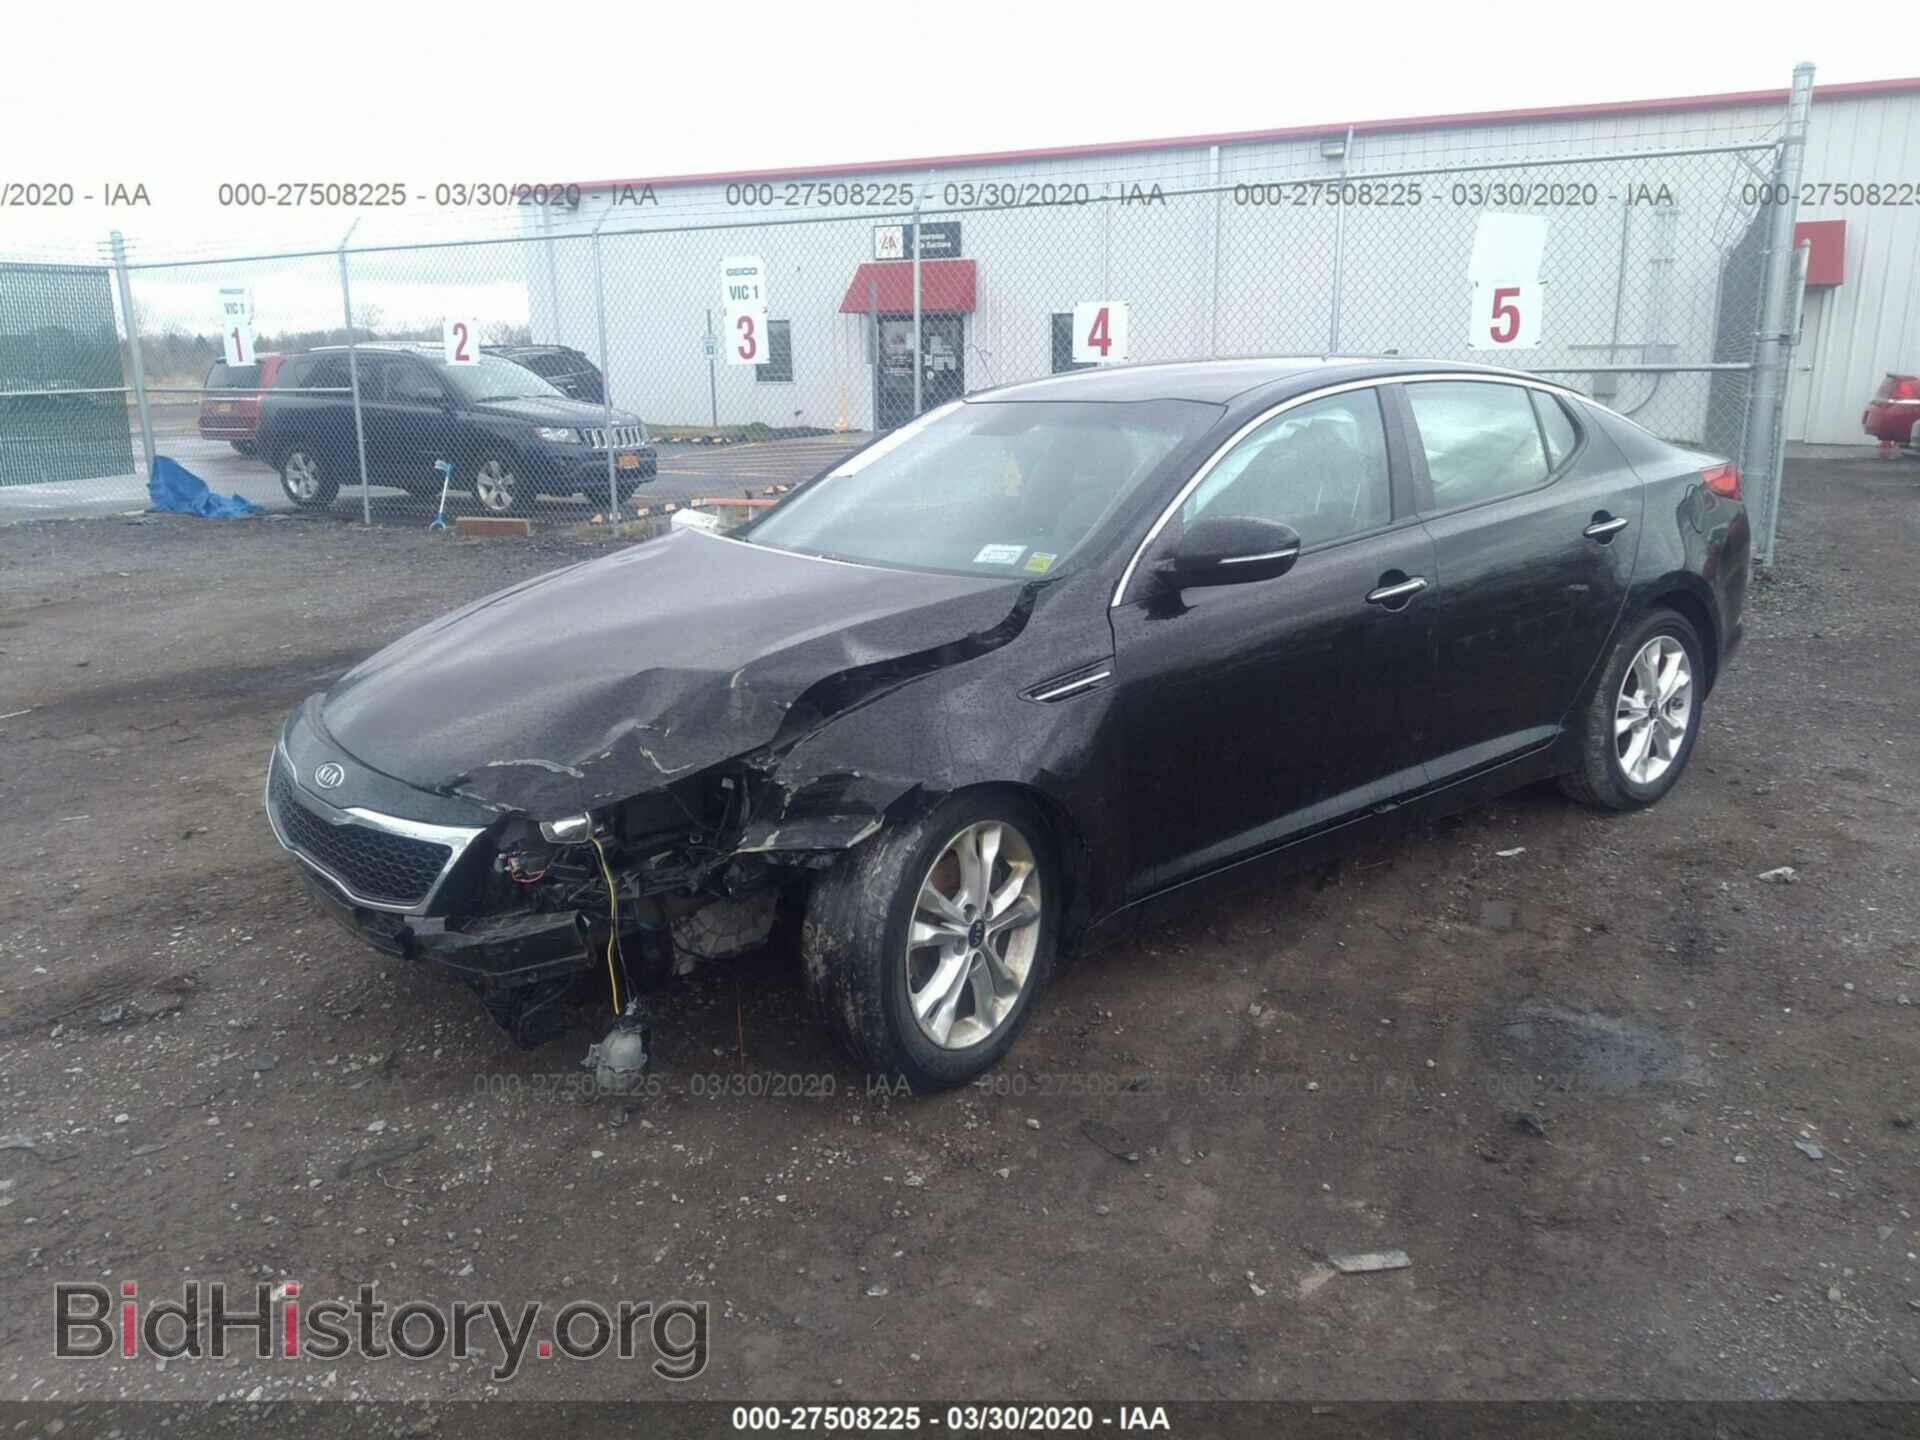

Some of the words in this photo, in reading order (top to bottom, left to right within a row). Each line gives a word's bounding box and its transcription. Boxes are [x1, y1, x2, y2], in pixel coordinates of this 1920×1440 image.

[729, 285, 749, 300] VIC
[752, 285, 759, 299] 1
[1087, 307, 1112, 357] 4
[1490, 287, 1520, 343] 5
[230, 327, 244, 362] 1
[453, 322, 470, 361] 2
[736, 315, 757, 360] 3
